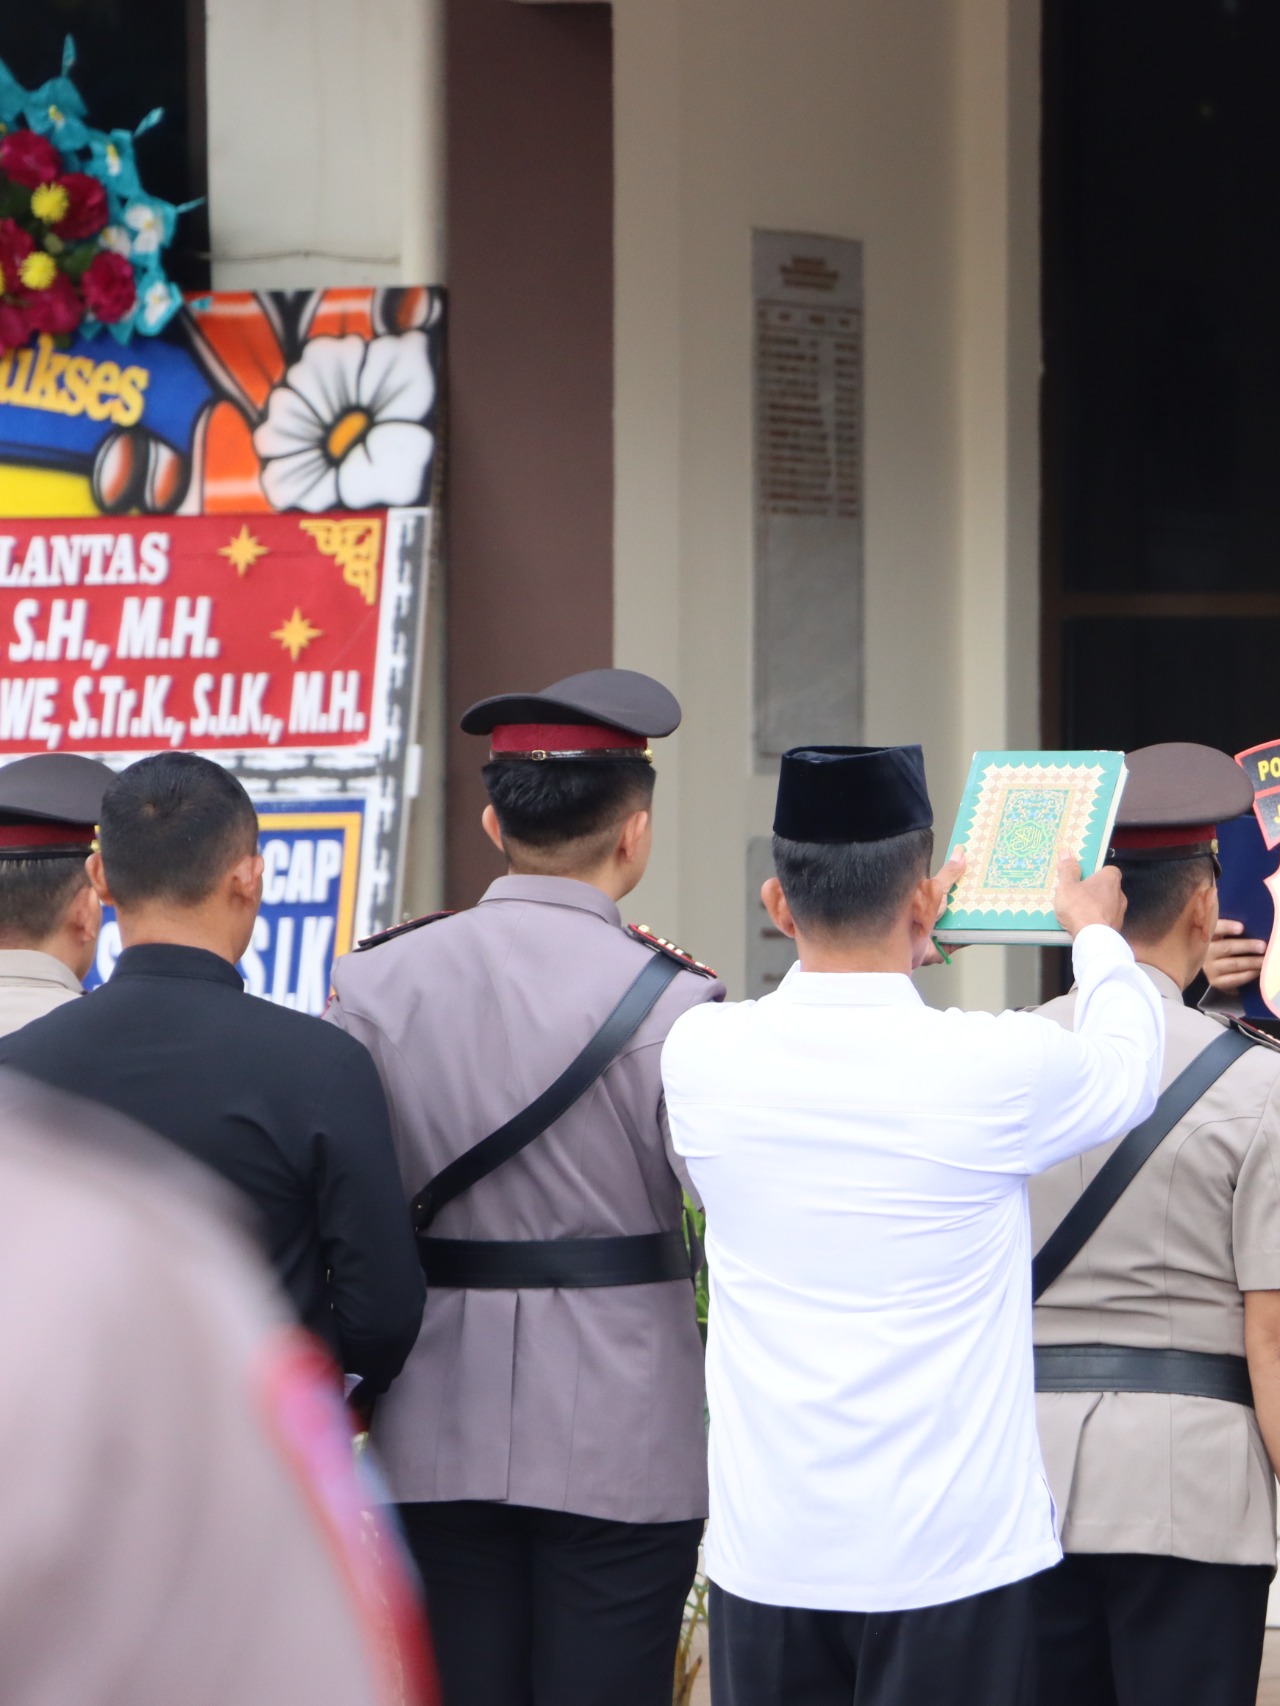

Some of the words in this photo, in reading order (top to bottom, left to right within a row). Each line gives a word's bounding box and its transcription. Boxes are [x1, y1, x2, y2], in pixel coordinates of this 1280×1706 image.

[0, 531, 169, 587] LANTAS
[116, 596, 219, 659] M.H.
[288, 670, 366, 734] M.H.
[257, 838, 342, 906] CAP
